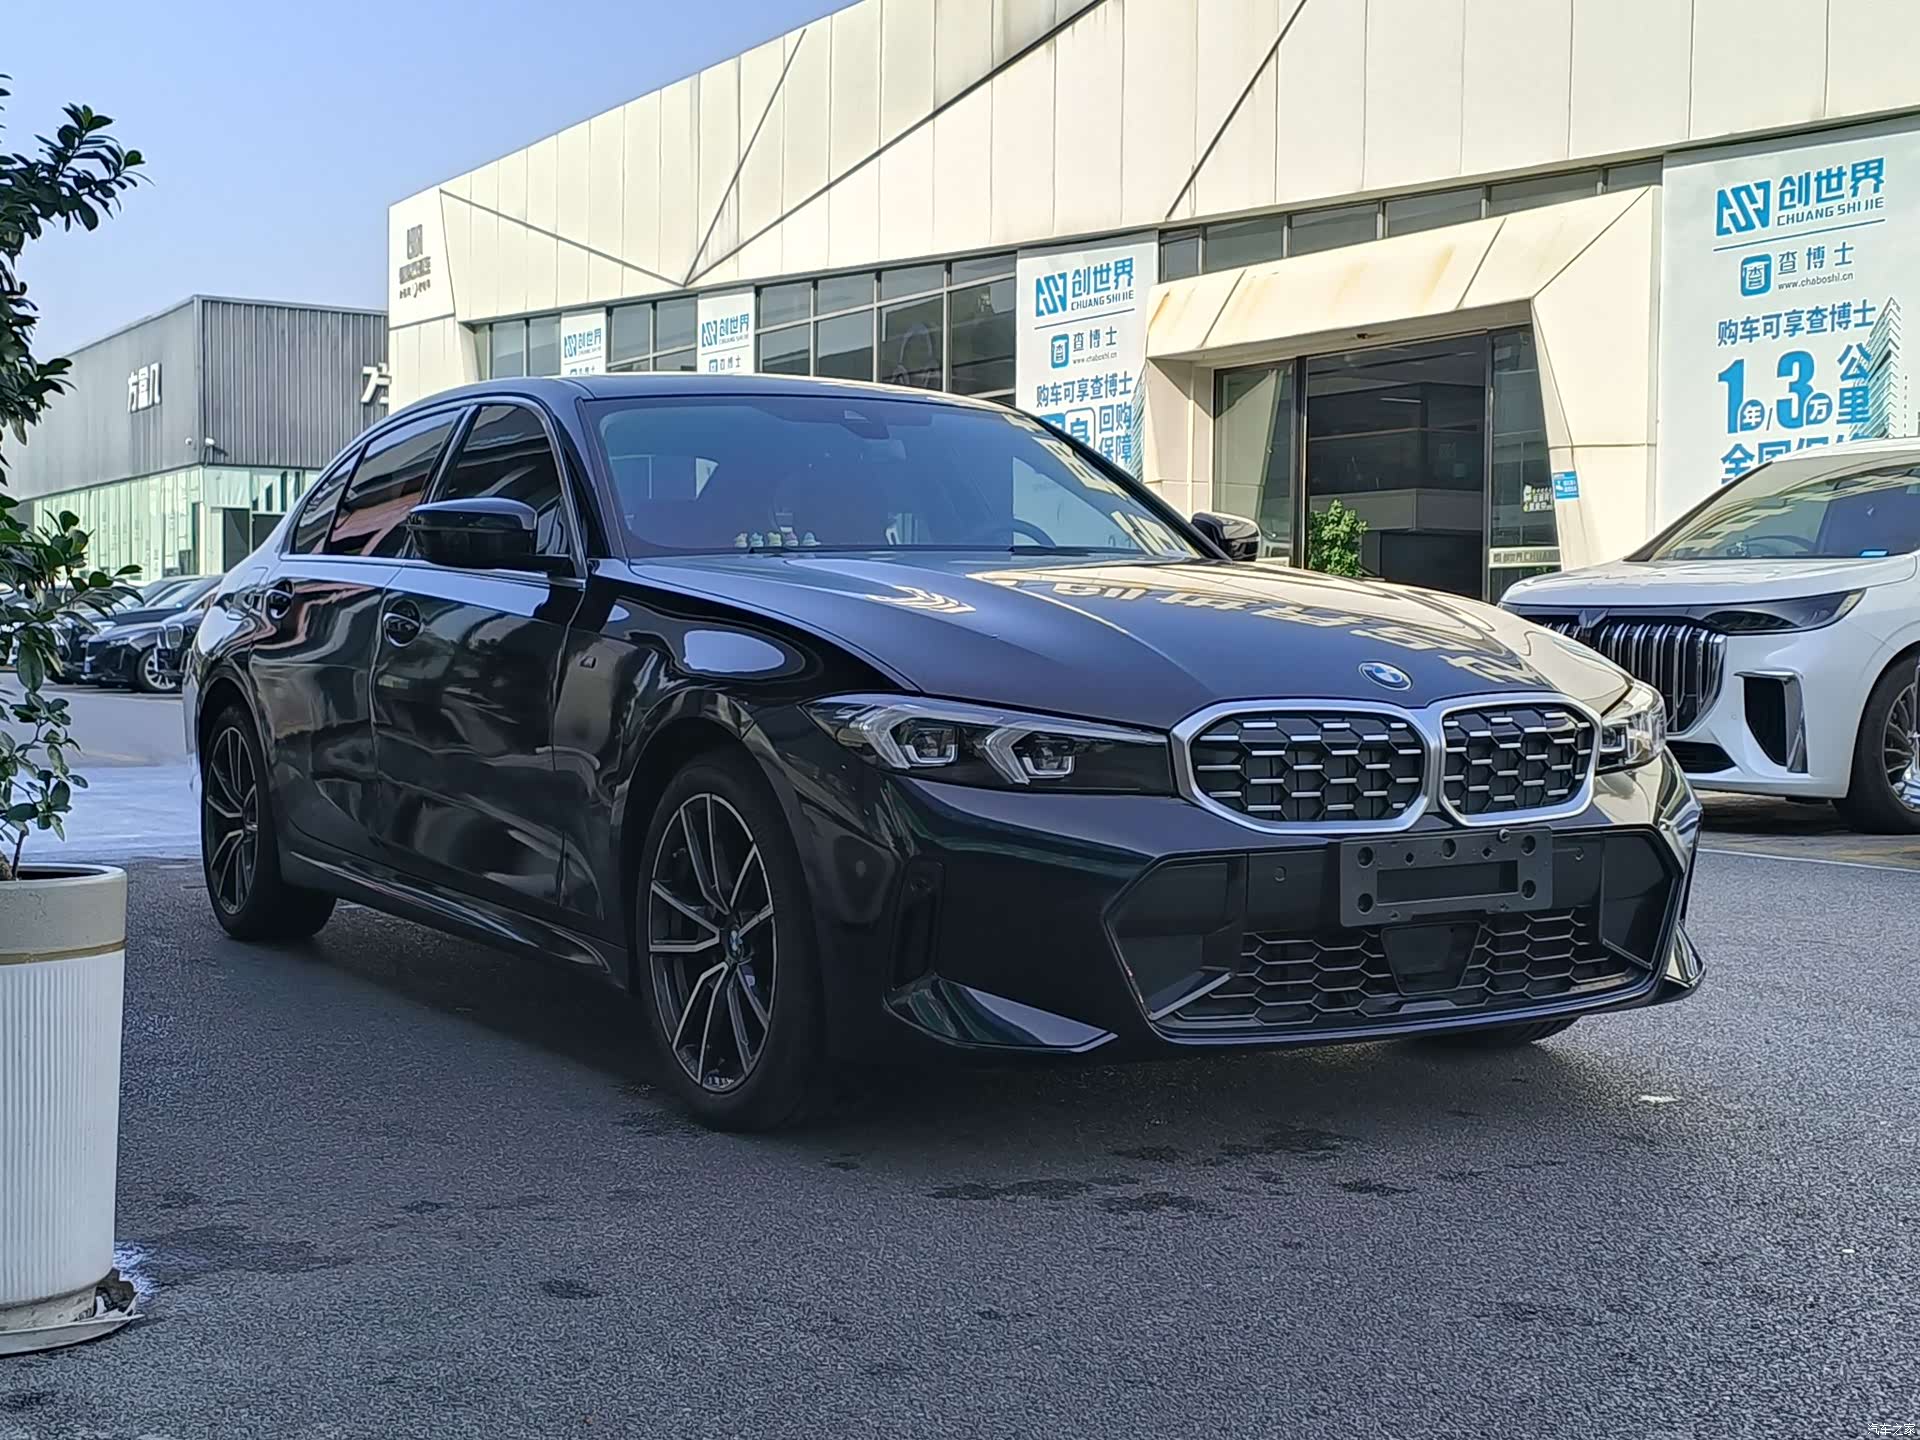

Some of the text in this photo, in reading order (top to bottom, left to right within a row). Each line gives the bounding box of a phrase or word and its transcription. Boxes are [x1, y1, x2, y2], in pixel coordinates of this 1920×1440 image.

[1778, 156, 1885, 212] 创世界
[1777, 196, 1884, 227] CHUANG SHI JIE
[1778, 241, 1854, 275] 查博士
[1072, 257, 1134, 298] 创世界
[1778, 272, 1854, 290] www.chaboshi.cn
[1071, 289, 1134, 311] CHUANG SHI JIE
[719, 313, 749, 337] 创世界
[1073, 325, 1117, 352] 查博士
[1717, 299, 1877, 347] 购车可享查博士
[1036, 370, 1133, 408] 购车可享查博士
